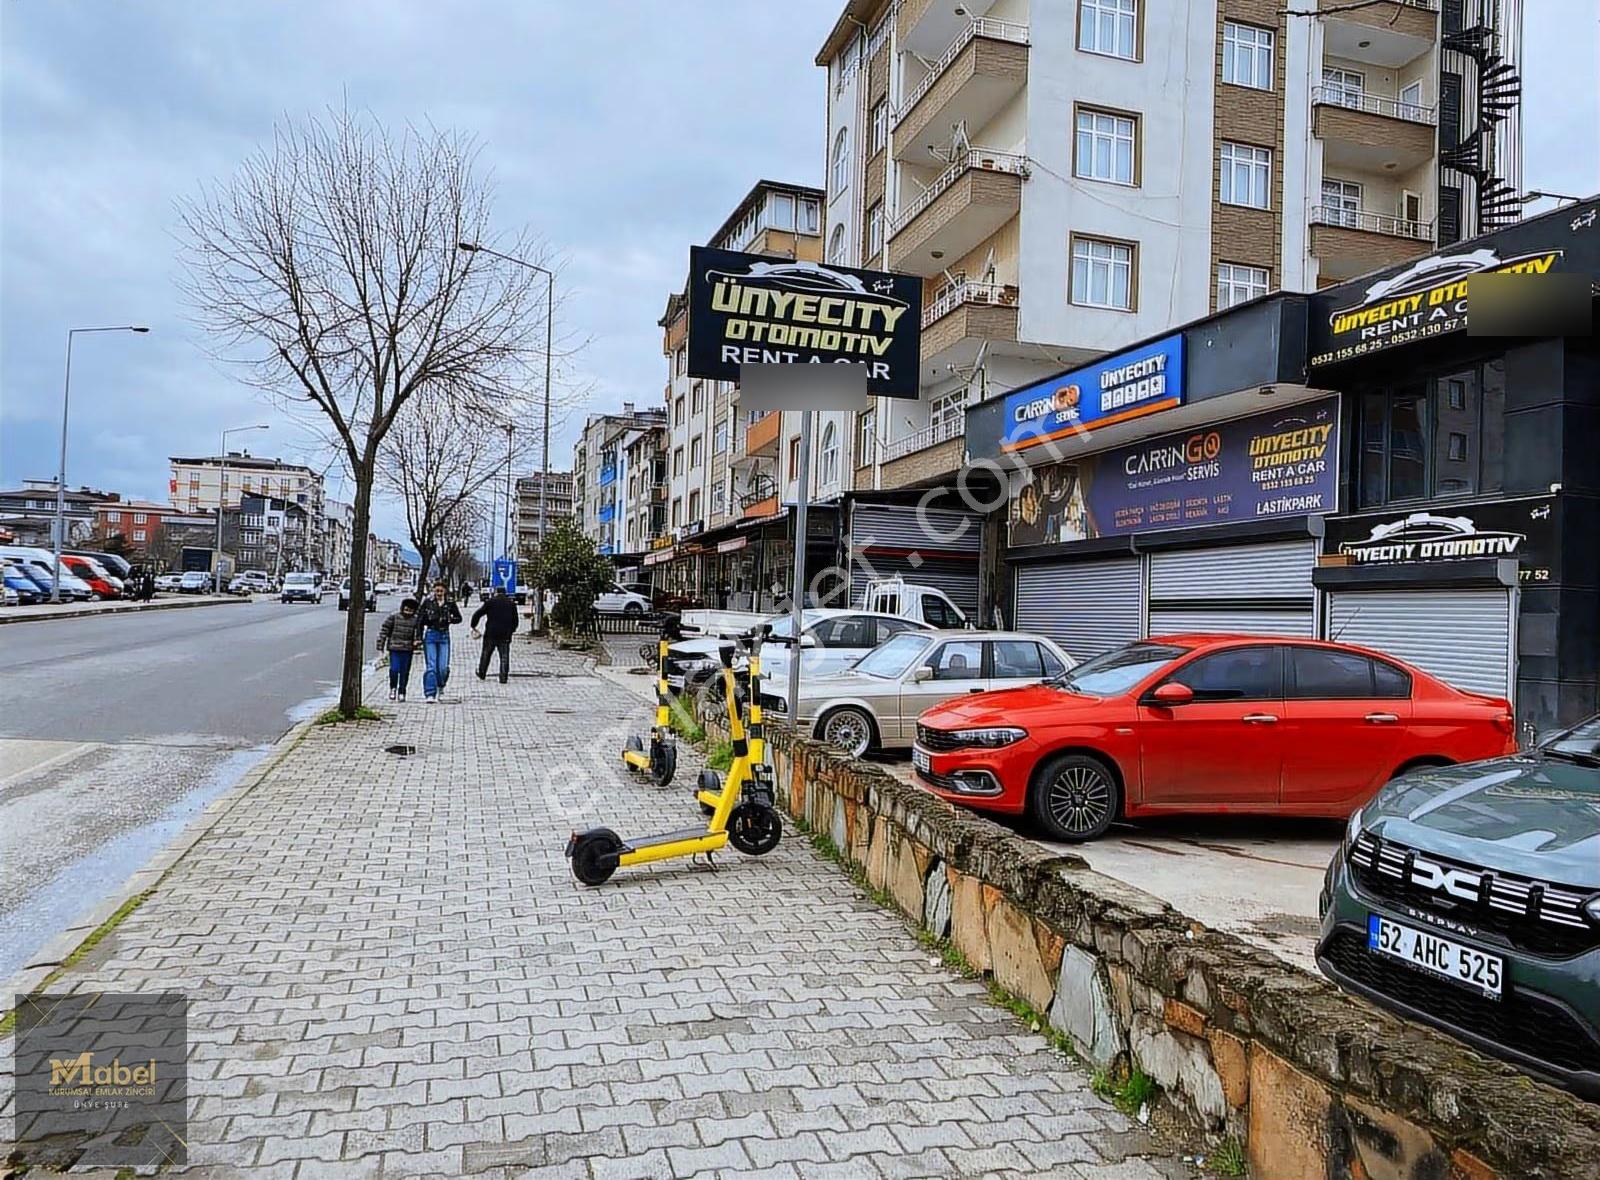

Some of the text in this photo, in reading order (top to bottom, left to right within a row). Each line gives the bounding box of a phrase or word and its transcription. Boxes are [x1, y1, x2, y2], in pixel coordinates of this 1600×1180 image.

[711, 277, 908, 333] ÜNYECITY
[1334, 293, 1425, 334] ÜNYECITY
[1361, 312, 1424, 340] RENT
[1429, 305, 1448, 319] A
[1311, 352, 1333, 366] 0532
[1336, 347, 1353, 359] 155
[1369, 339, 1382, 350] 25
[1391, 329, 1418, 344] 0532
[1421, 323, 1441, 336] 130
[1445, 319, 1458, 330] 57
[1249, 423, 1333, 457] ÜNYECITY
[1186, 461, 1220, 482] SERVİS
[1252, 460, 1325, 482] RENT A CAR
[1256, 494, 1322, 515] LASTİKPARK
[1534, 569, 1549, 580] 52
[1379, 921, 1402, 952] 52
[1412, 934, 1450, 970] AHC
[1459, 950, 1501, 989] 525
